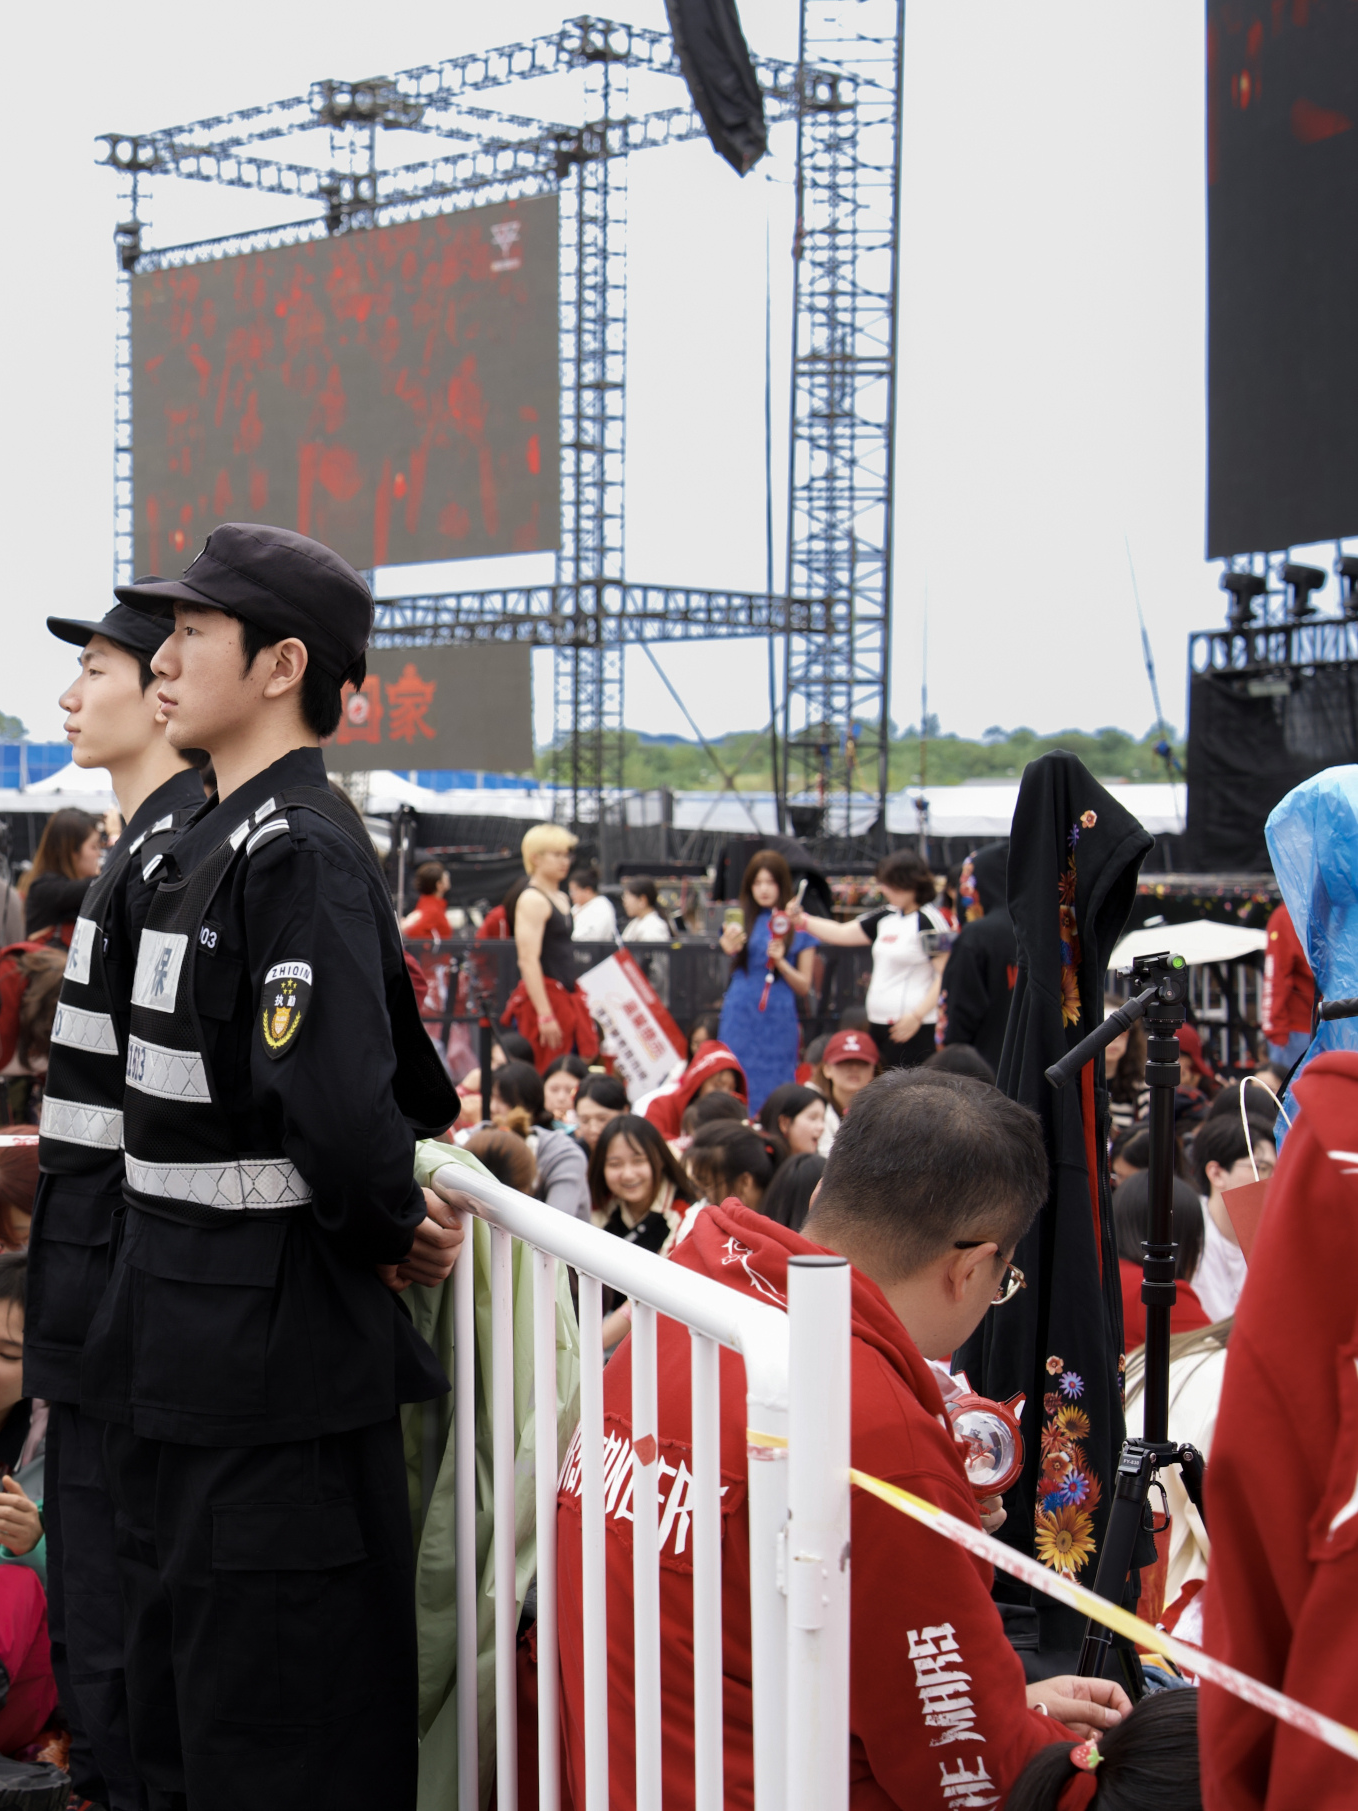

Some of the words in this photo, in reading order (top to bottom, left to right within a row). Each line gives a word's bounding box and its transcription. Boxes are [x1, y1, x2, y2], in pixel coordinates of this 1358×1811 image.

[198, 925, 218, 949] 03
[271, 965, 311, 980] ZHIQIN
[906, 1622, 987, 1748] MARS
[939, 1756, 1002, 1811] HE
